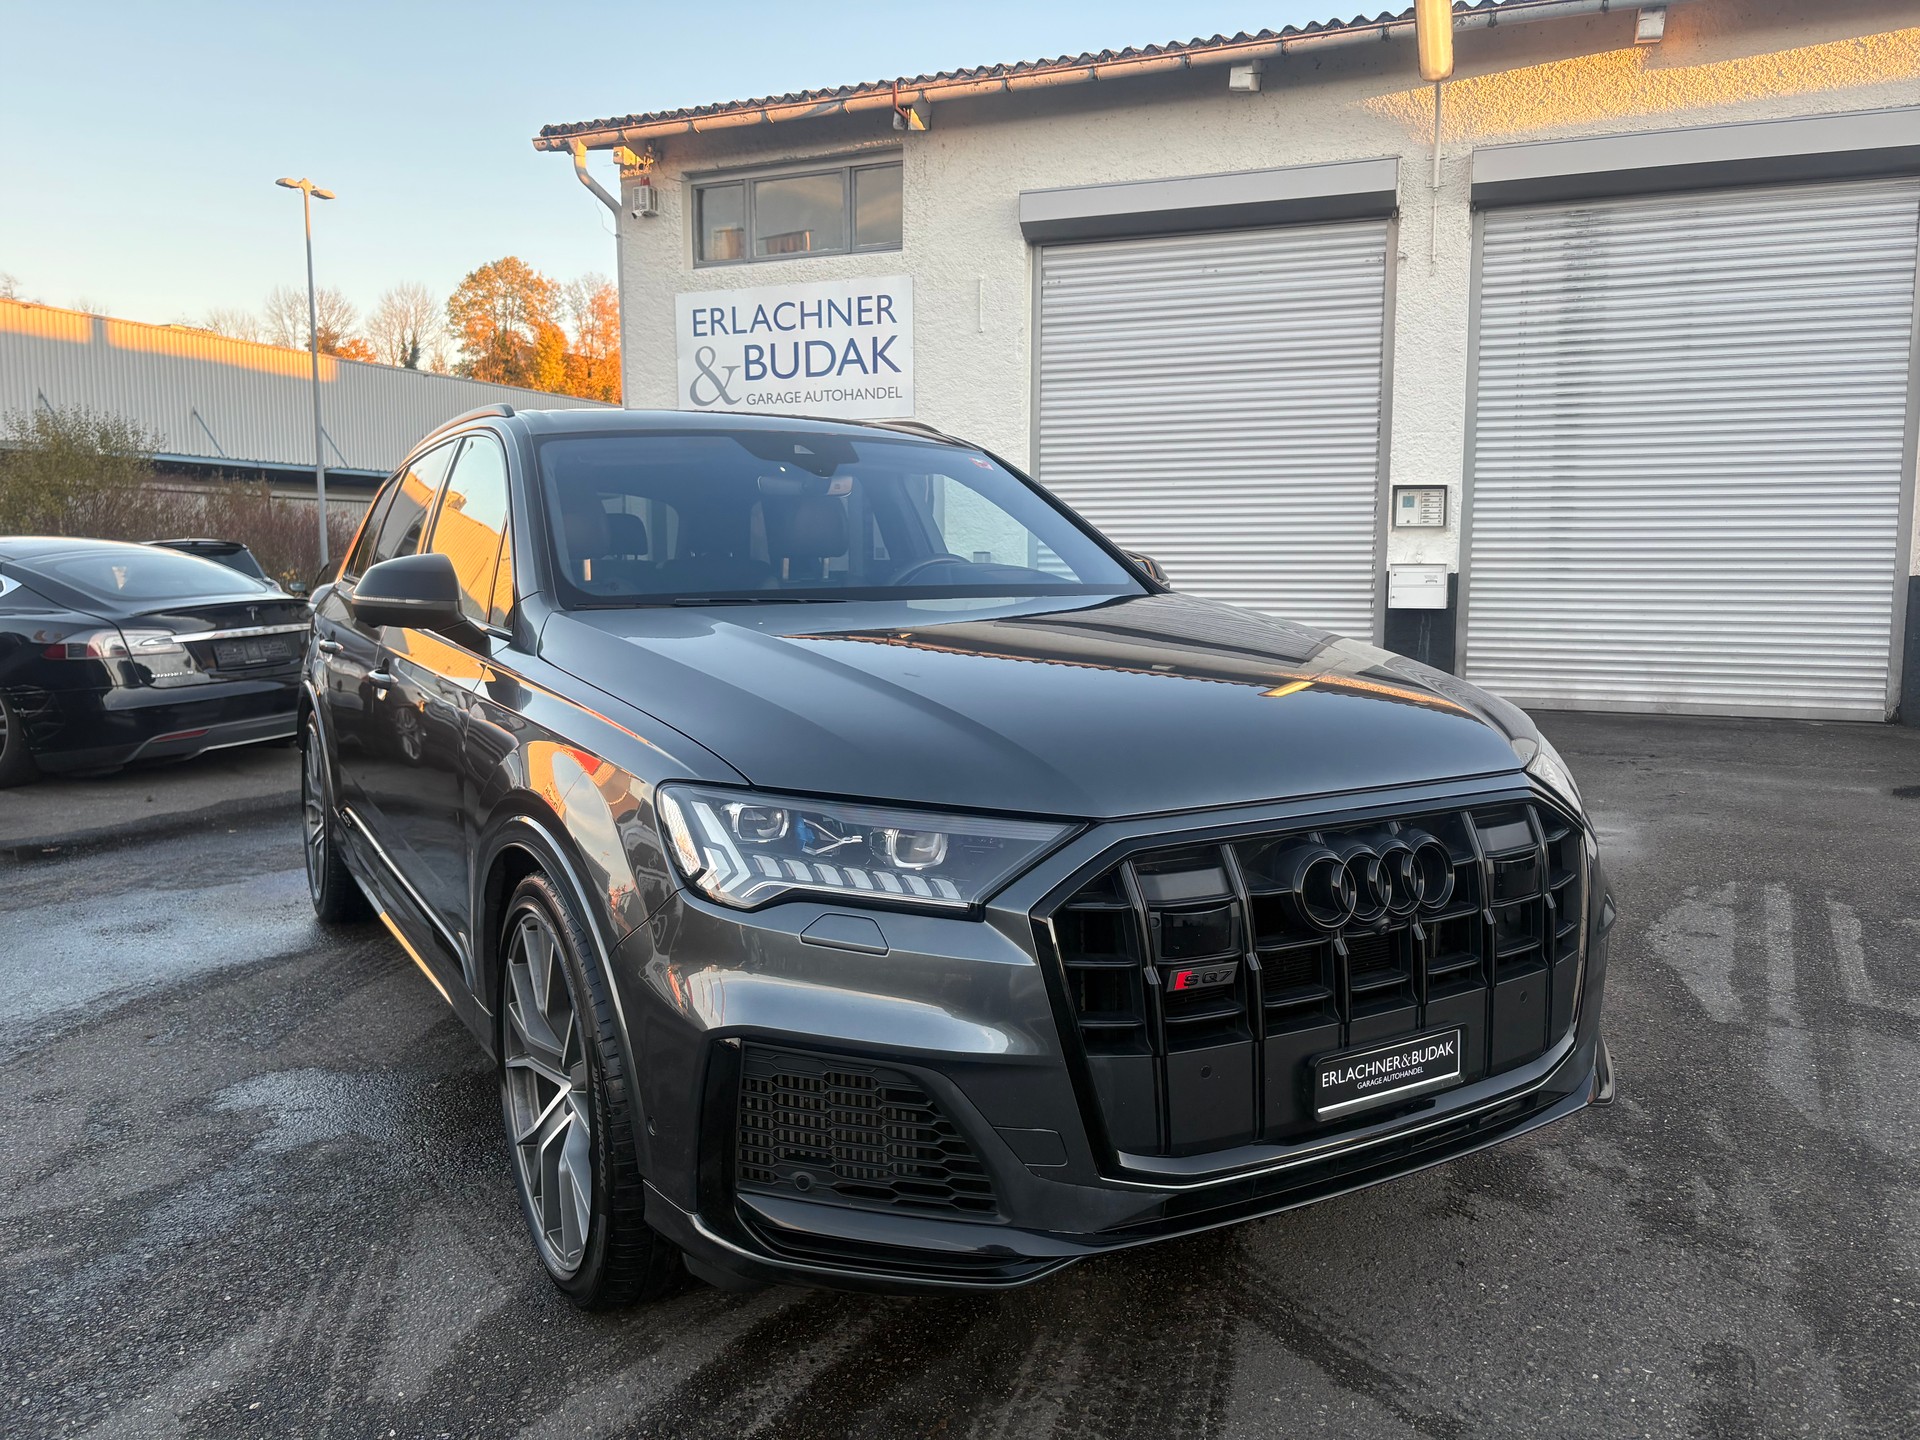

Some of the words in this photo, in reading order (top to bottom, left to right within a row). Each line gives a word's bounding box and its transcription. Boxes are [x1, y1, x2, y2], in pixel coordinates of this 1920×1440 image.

[692, 294, 898, 337] ERLACHNER
[689, 345, 742, 407] &
[743, 335, 902, 381] BUDAK
[746, 391, 801, 406] GARAGE
[804, 386, 903, 403] AUTOHANDEL
[1356, 1076, 1382, 1089] GARAGE
[1382, 1066, 1424, 1083] AUTOHANDEL
